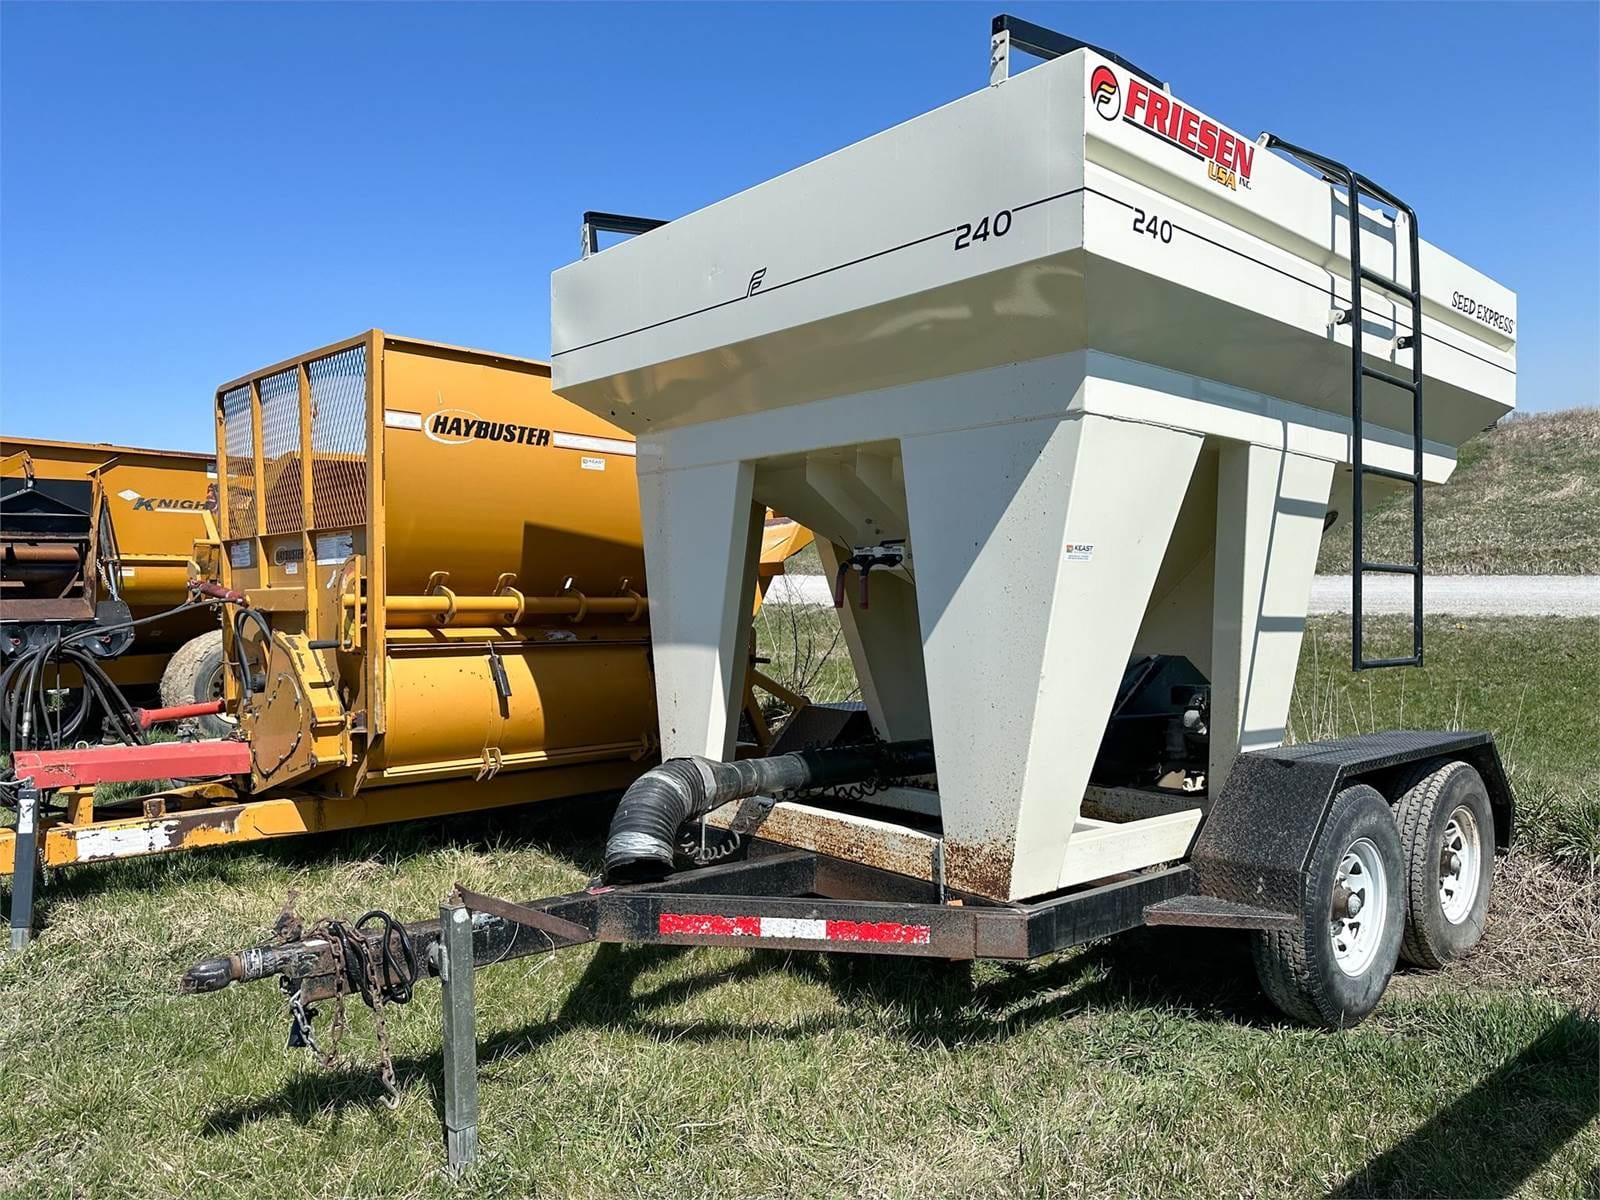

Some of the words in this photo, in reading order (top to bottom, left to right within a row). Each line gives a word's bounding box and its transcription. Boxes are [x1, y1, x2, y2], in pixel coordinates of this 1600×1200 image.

[1124, 78, 1255, 179] FRIESEN
[1207, 160, 1237, 191] USA
[954, 209, 1012, 251] 240
[1132, 207, 1173, 244] 240
[1451, 290, 1476, 315] SEED
[1476, 304, 1514, 334] EXPRESS
[432, 415, 551, 447] HAYBUSTER
[133, 497, 207, 512] KNIGH
[1074, 544, 1094, 552] KEAST
